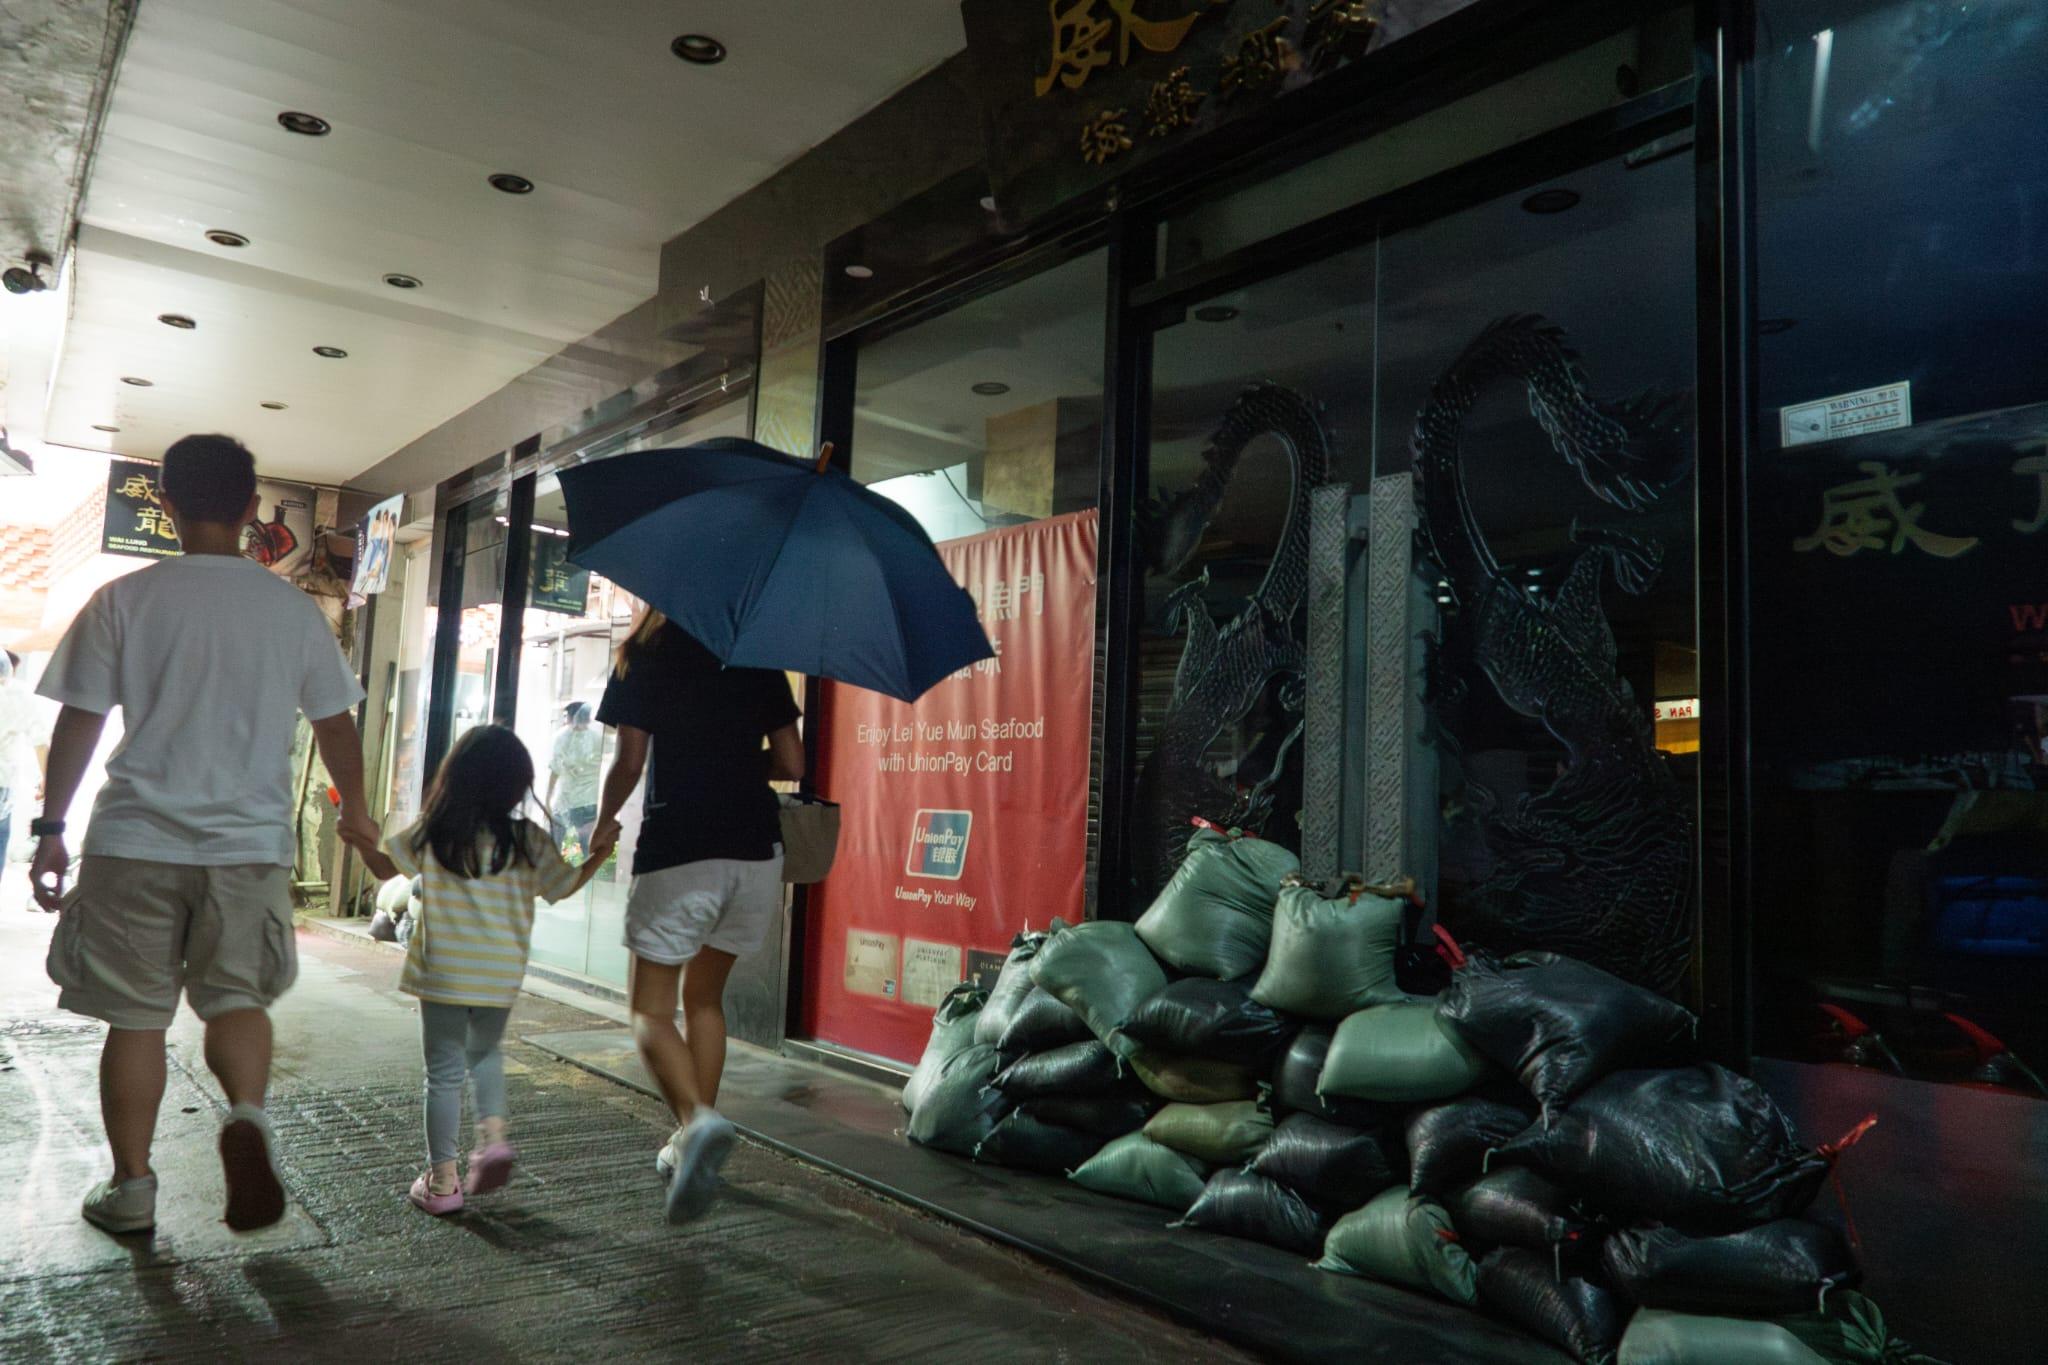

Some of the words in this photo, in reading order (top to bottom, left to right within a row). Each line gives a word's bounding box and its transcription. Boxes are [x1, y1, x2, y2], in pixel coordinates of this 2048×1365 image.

[975, 573, 1045, 622] 魚門
[857, 723, 891, 747] Enjoy
[893, 722, 913, 742] Lei
[917, 721, 944, 742] Yue
[947, 719, 977, 741] Mun
[980, 715, 1045, 739] Seafood
[878, 752, 905, 772] with
[908, 750, 973, 777] UnionPay
[976, 750, 1013, 772] Card
[916, 826, 964, 851] UnionPay
[895, 885, 932, 908] UnionPay
[933, 889, 954, 905] Your
[955, 892, 977, 912] Way
